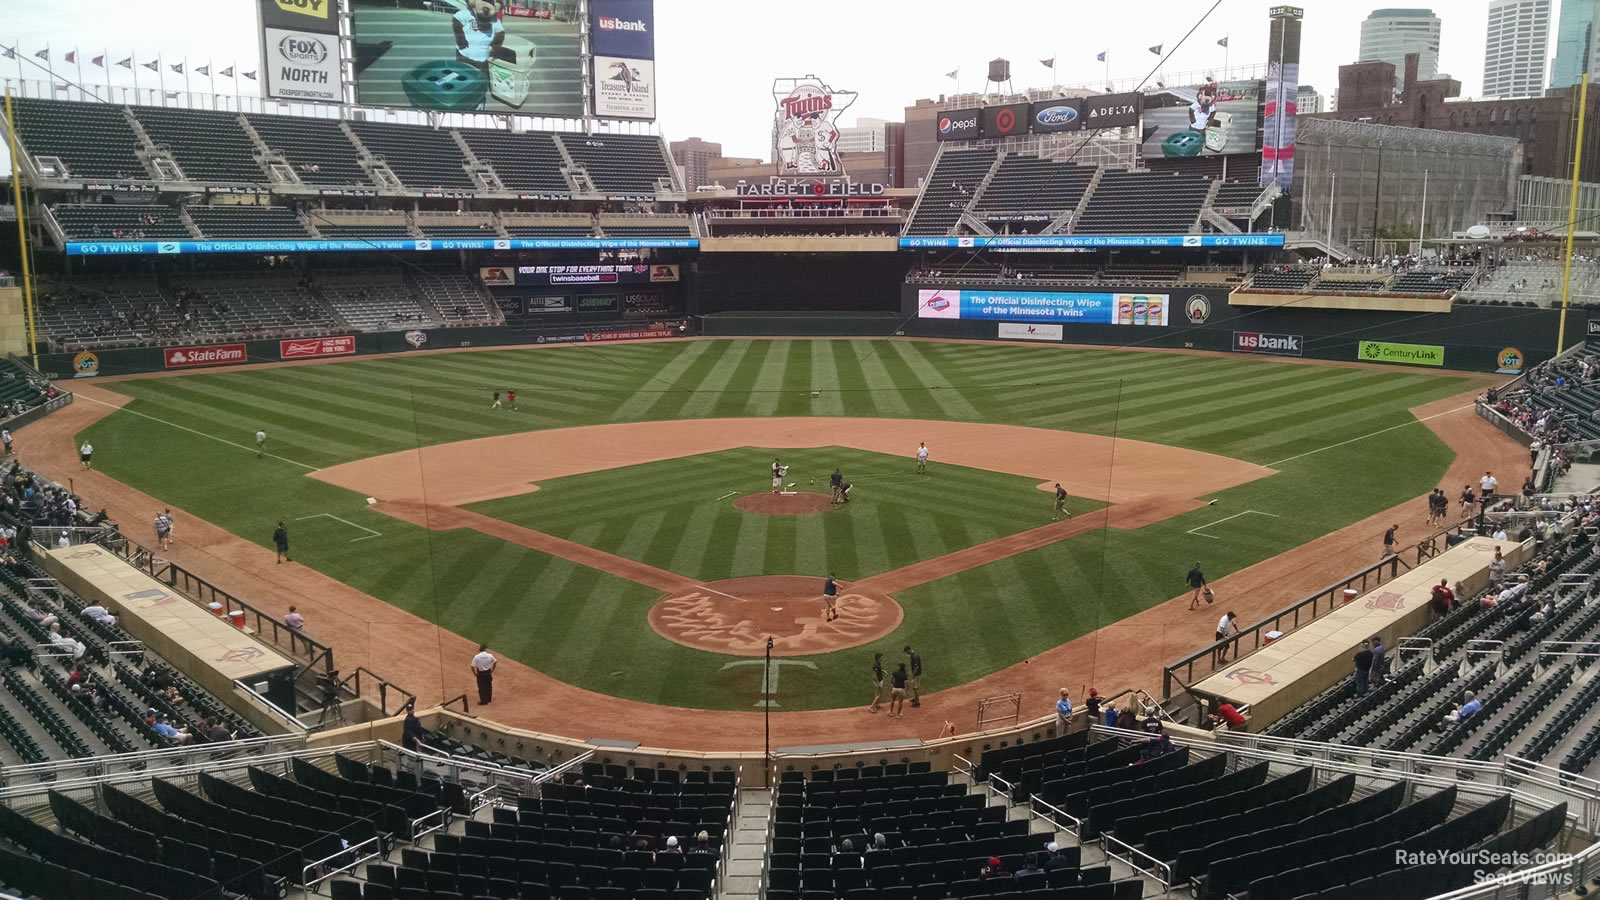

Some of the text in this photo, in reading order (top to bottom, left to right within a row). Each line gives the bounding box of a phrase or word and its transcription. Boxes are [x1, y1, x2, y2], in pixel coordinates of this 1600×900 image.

[289, 40, 317, 54] FOX
[281, 66, 329, 84] NORTH
[600, 81, 649, 93] Treasure Island
[780, 94, 832, 120] Twins
[1100, 104, 1135, 117] DELTA
[1045, 109, 1071, 123] Ford
[952, 117, 977, 133] pepsi
[736, 184, 885, 196] TARGET FIELD
[247, 242, 295, 251] Disinfecting
[297, 242, 318, 250] Wipe
[384, 241, 404, 249] Twins
[442, 241, 484, 249] GO TWINS!
[561, 240, 600, 248] Disinfecting
[601, 240, 618, 248] Wipe
[1023, 238, 1062, 246] Disinfecting
[1065, 238, 1082, 246] Wipe
[1107, 237, 1144, 245] Minnesota
[1145, 237, 1168, 245] Twins
[1232, 238, 1268, 246] TWINS!
[81, 243, 143, 252] GO TWINS!
[566, 265, 579, 273] FOR
[579, 265, 614, 273] EVERYTHING
[579, 297, 616, 307] SUBWAY
[970, 296, 1102, 308] The Official Disinfecting Wipe
[983, 306, 1084, 317] of the Minnesota Twins
[1383, 347, 1436, 360] CenturyLink
[1500, 357, 1520, 366] VOTE
